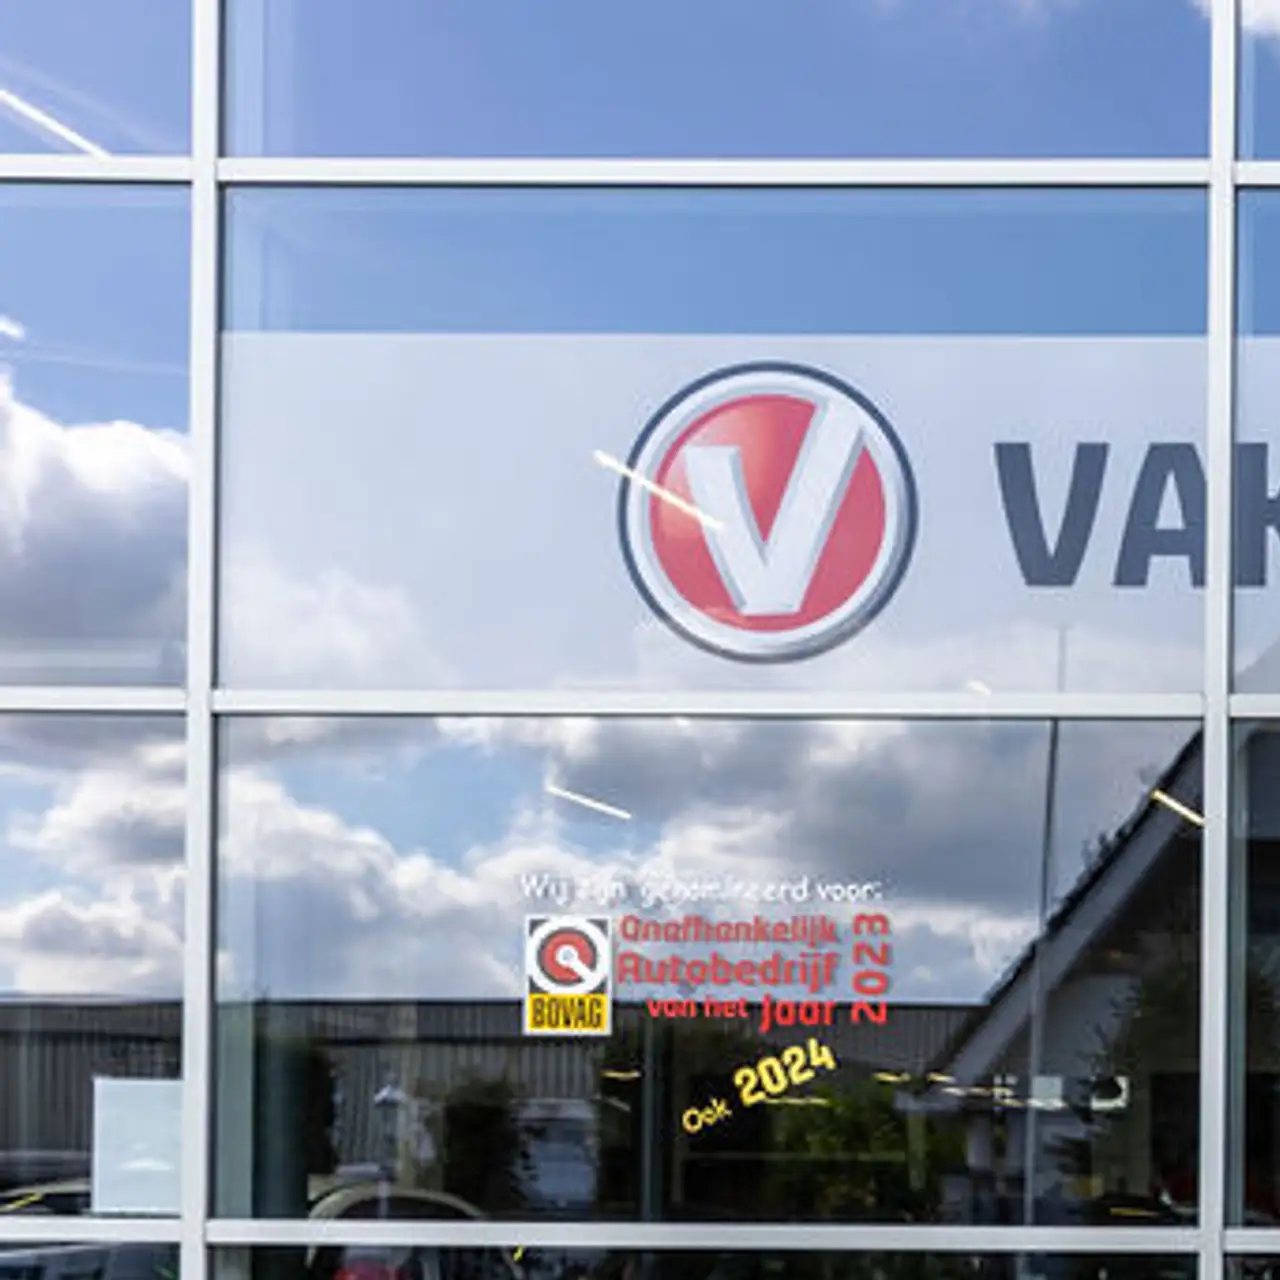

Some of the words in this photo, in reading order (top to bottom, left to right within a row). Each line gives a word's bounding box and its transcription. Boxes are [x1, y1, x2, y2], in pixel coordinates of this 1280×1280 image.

[620, 914, 839, 949] Onafhankelijk
[616, 951, 839, 994] Autobedrijf
[852, 912, 891, 1024] 2023
[531, 997, 604, 1029] BOVAG
[646, 998, 696, 1018] van
[704, 994, 749, 1018] het
[734, 1037, 836, 1107] 2024
